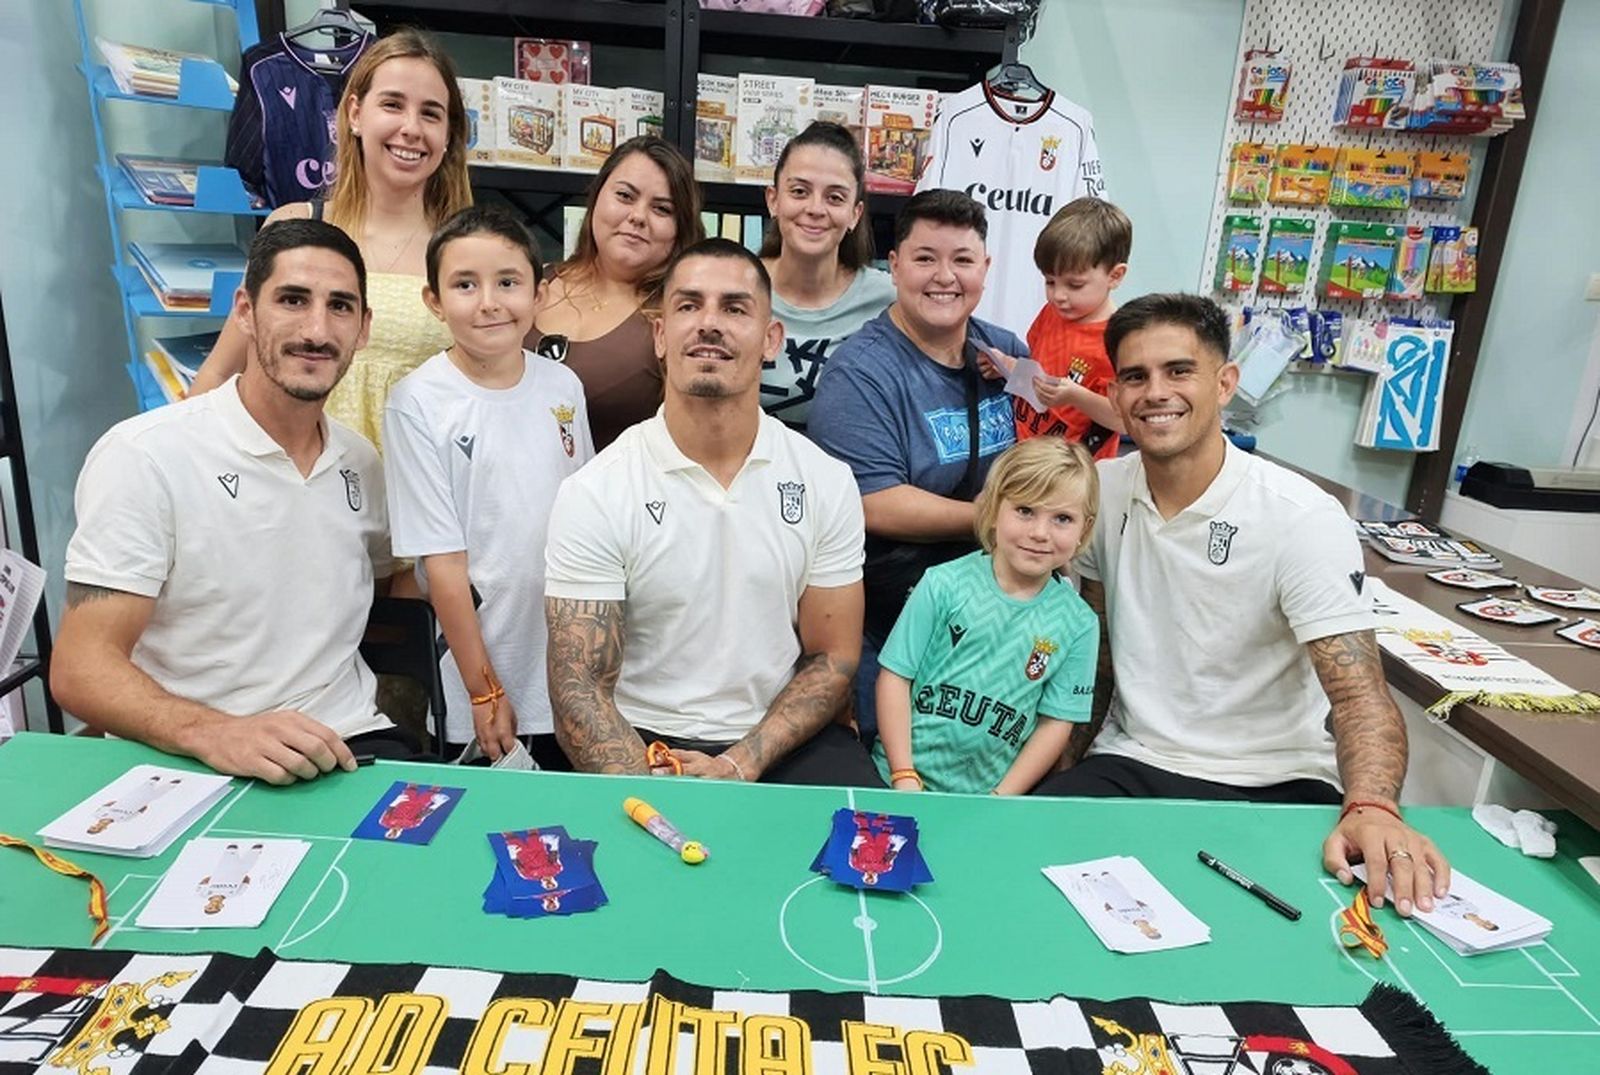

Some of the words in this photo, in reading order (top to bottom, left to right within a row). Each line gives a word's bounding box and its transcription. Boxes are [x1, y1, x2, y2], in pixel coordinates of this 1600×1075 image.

[743, 80, 777, 90] STREET
[914, 683, 1028, 747] CEUTA
[263, 992, 451, 1075] AD
